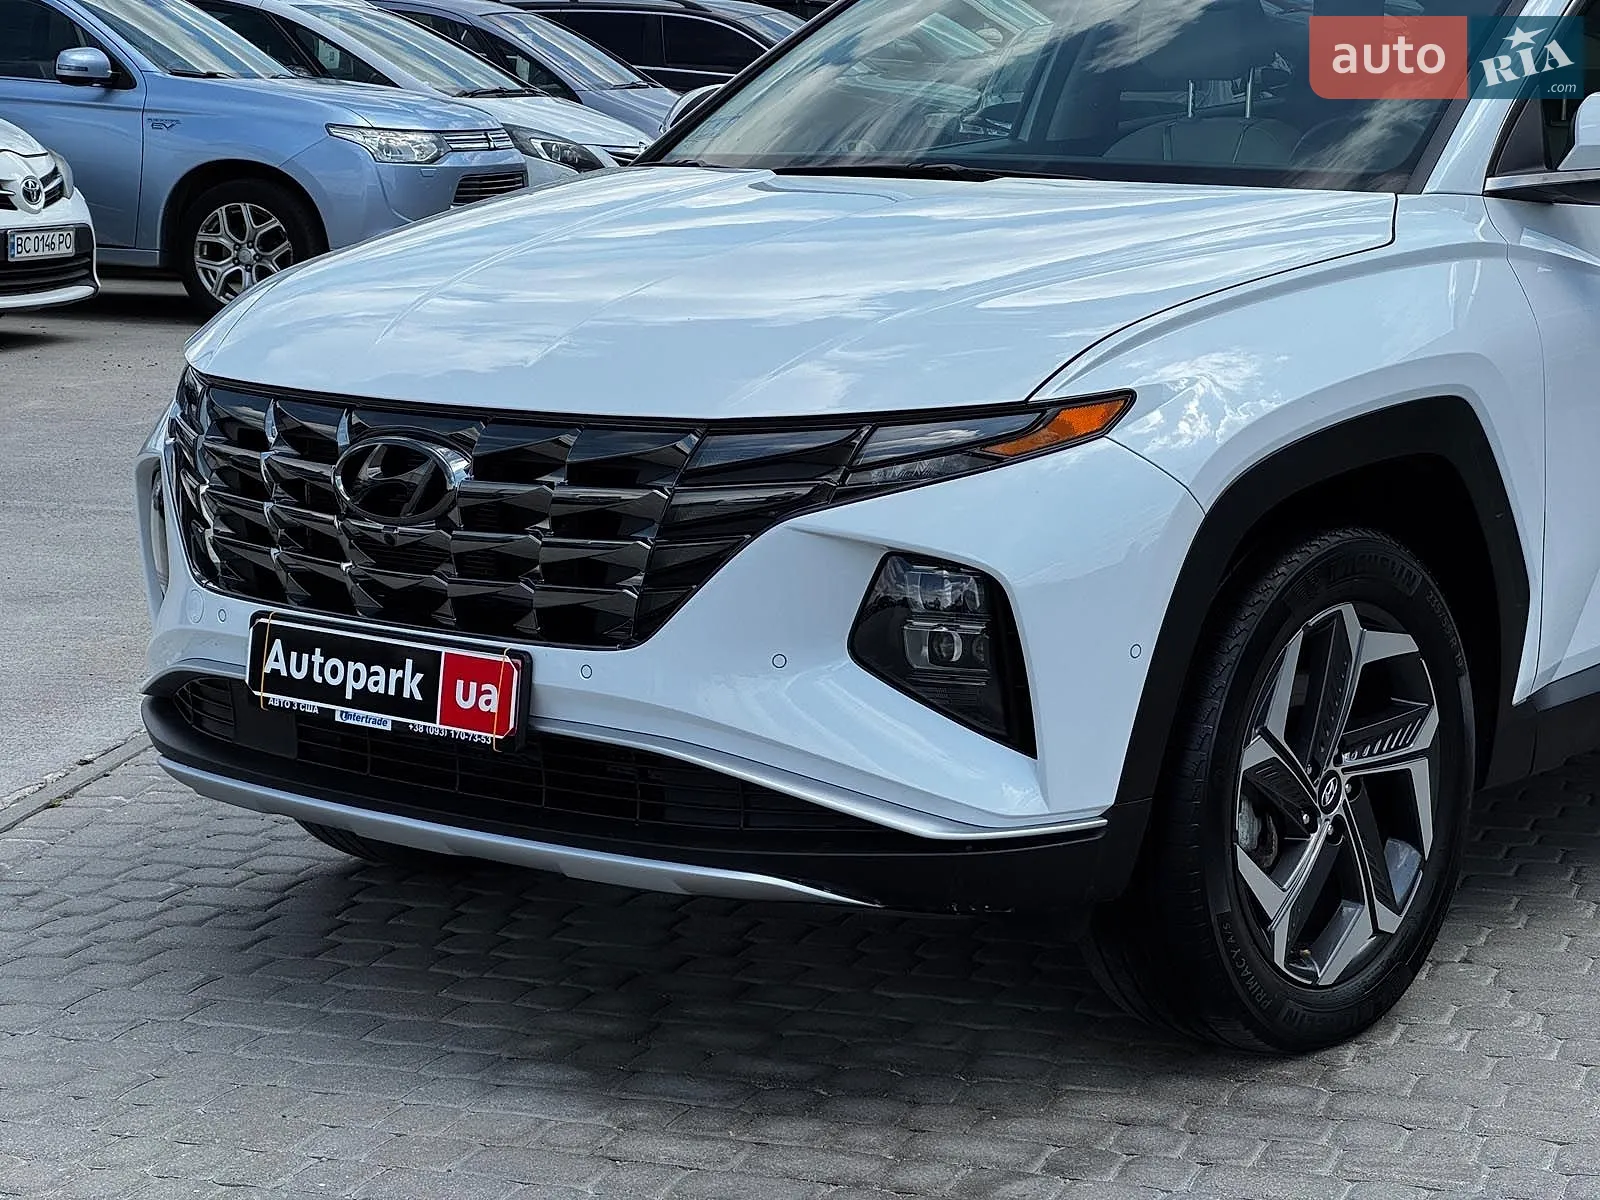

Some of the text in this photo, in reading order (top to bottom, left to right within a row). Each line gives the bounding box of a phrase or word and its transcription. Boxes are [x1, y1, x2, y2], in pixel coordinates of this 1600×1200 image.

[16, 236, 31, 254] BC
[33, 232, 56, 253] 0146
[58, 232, 72, 251] PO
[264, 638, 498, 713] Autopark ua
[268, 697, 290, 709] АВТО
[300, 703, 319, 714] США
[408, 723, 492, 744] +38 (093) 170-73-53
[1230, 948, 1272, 1010] PRIMACY
